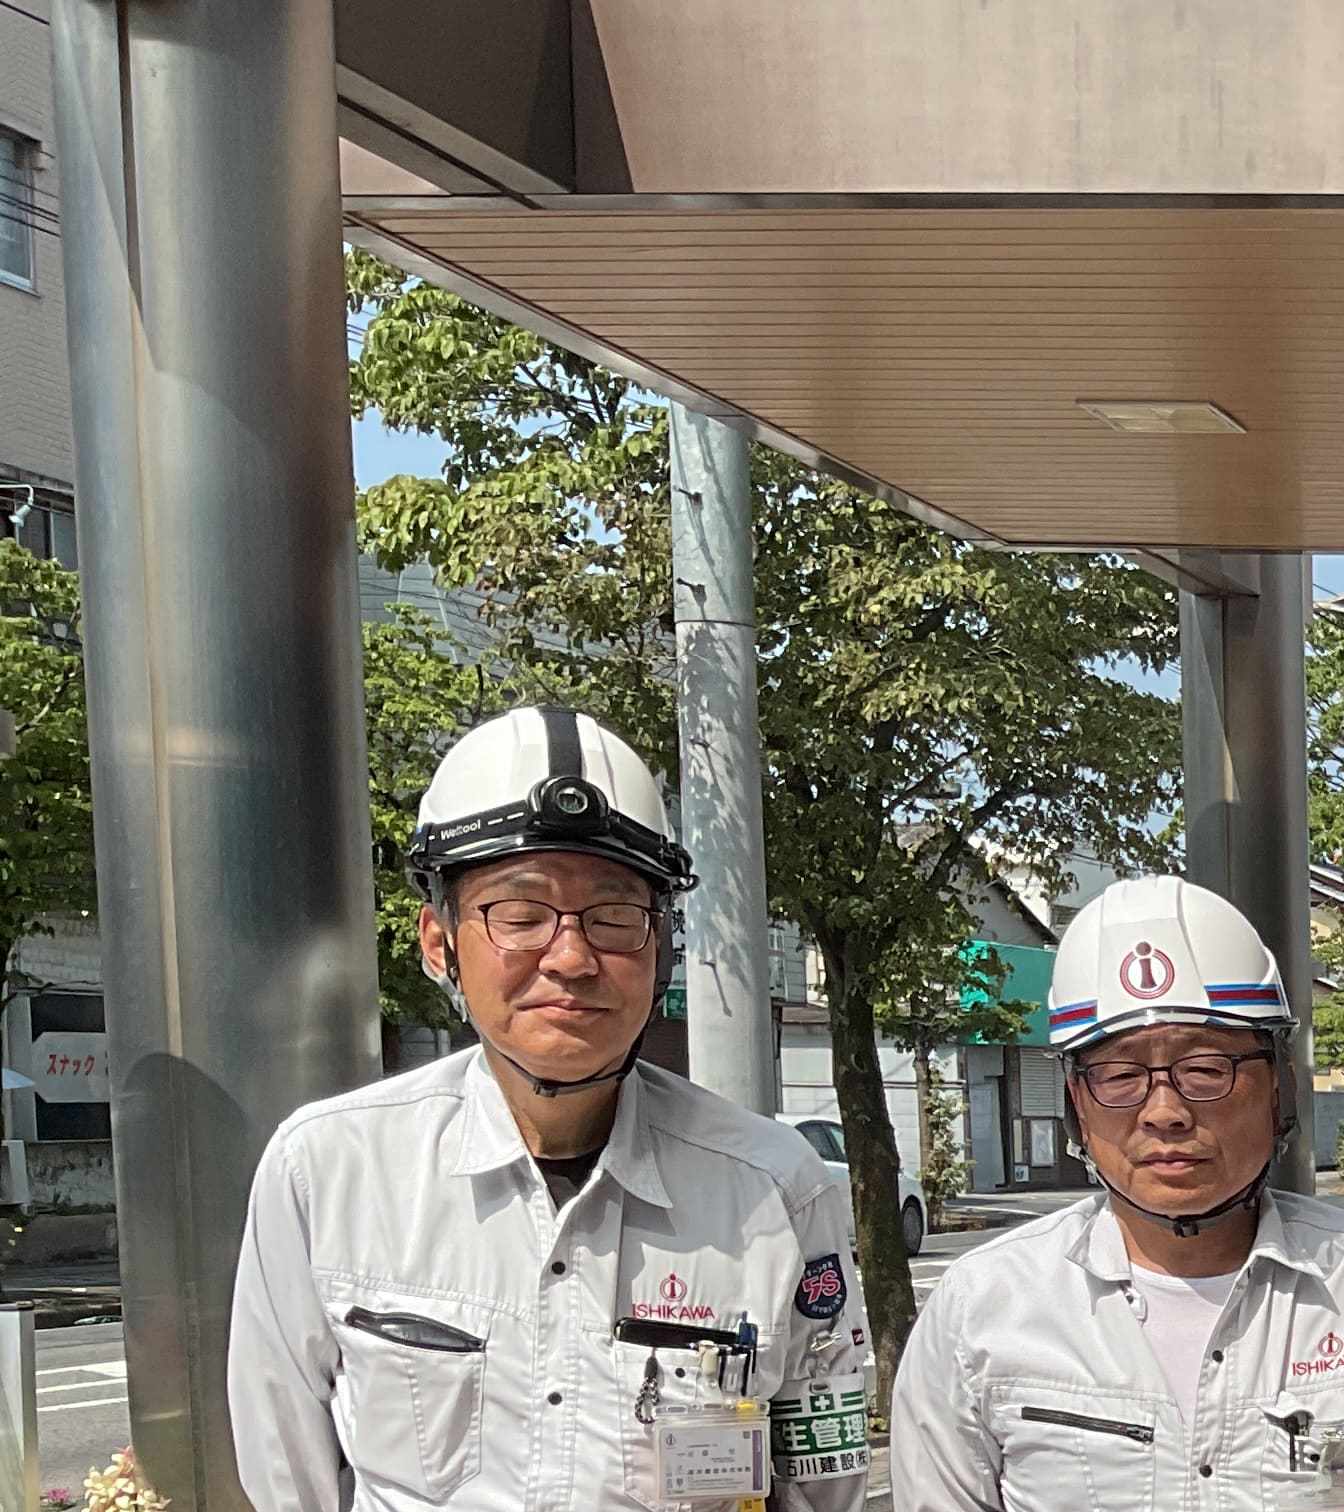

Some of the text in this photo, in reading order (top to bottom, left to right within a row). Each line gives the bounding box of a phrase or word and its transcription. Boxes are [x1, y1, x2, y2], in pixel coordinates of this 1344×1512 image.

[47, 1054, 95, 1076] スナック
[801, 1270, 841, 1304] 5S
[632, 1303, 715, 1319] ISHIKAWA
